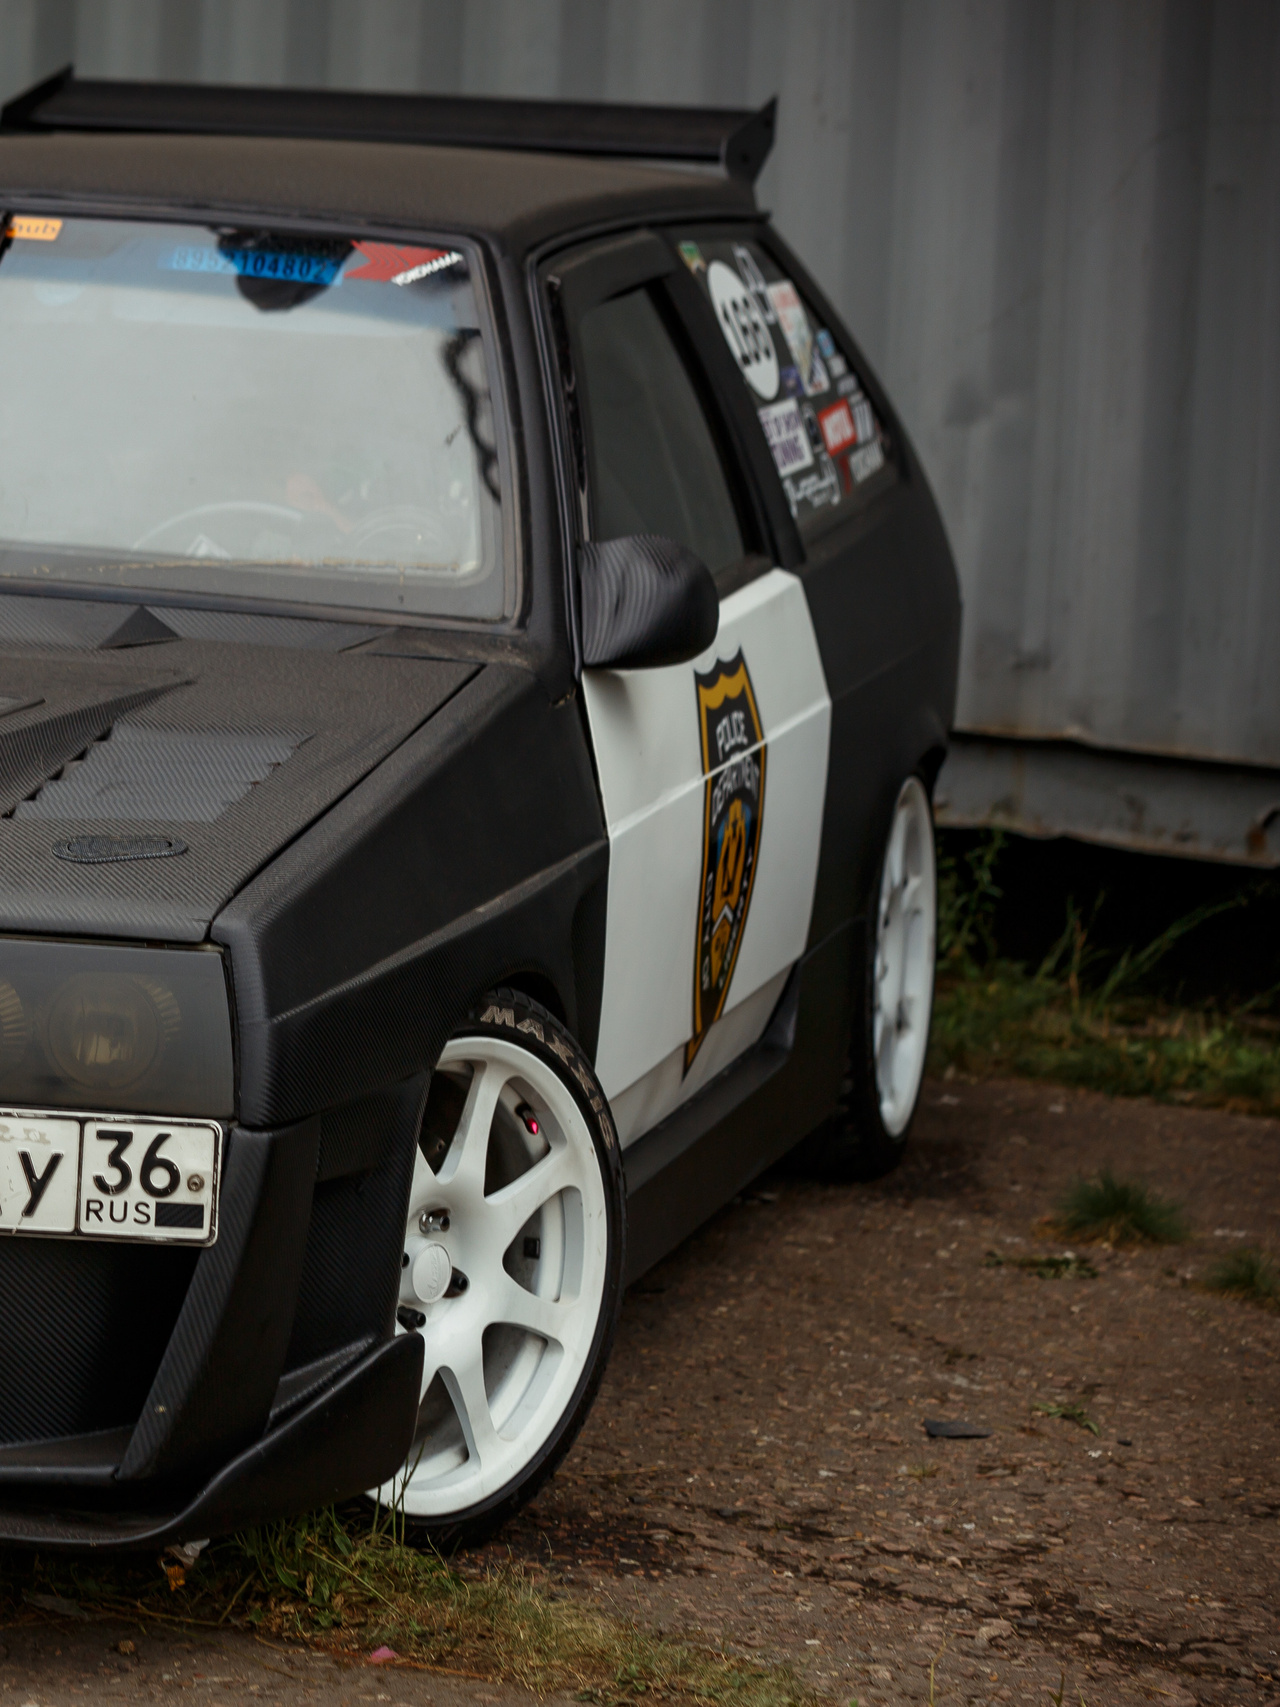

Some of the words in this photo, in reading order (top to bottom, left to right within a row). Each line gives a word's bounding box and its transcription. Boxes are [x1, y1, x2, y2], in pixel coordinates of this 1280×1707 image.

[716, 710, 748, 762] POLICE
[480, 1005, 615, 1150] MAXXIS
[93, 1129, 181, 1199] 36
[86, 1199, 151, 1224] RUS
